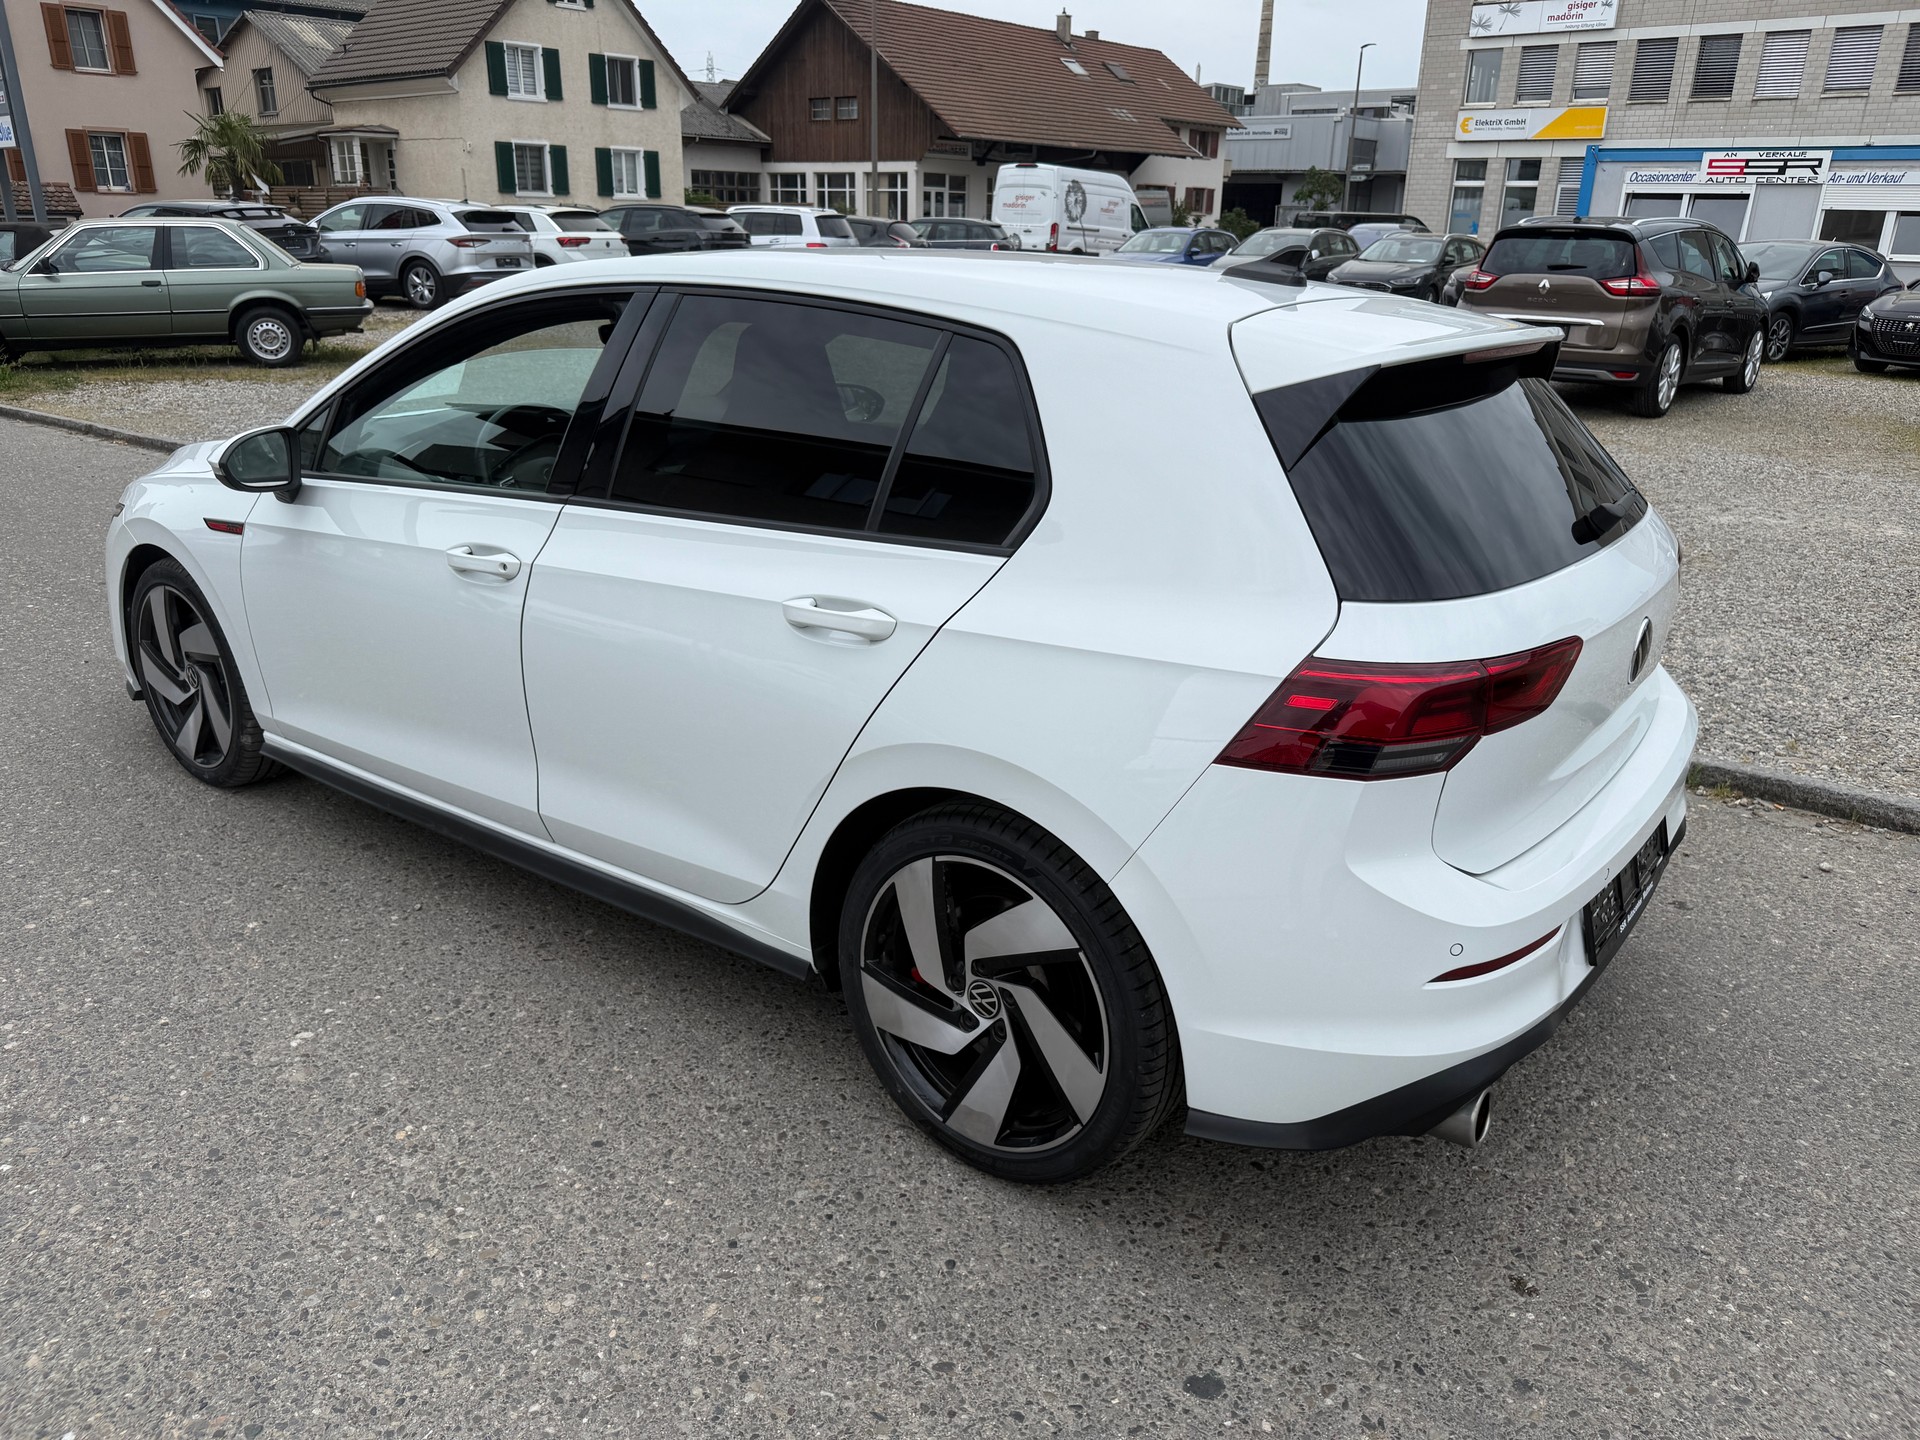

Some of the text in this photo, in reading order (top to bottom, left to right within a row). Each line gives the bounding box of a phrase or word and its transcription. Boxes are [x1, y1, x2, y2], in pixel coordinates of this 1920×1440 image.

[1567, 0, 1598, 12] gisiger
[1547, 12, 1583, 21] madörin
[1475, 118, 1527, 126] ElektriX GmbH
[1629, 171, 1697, 183] Occasioncenter
[1704, 176, 1819, 184] AUTO CENTER
[1827, 171, 1907, 184] An- und Verkauf
[959, 838, 1013, 862] SPORT
